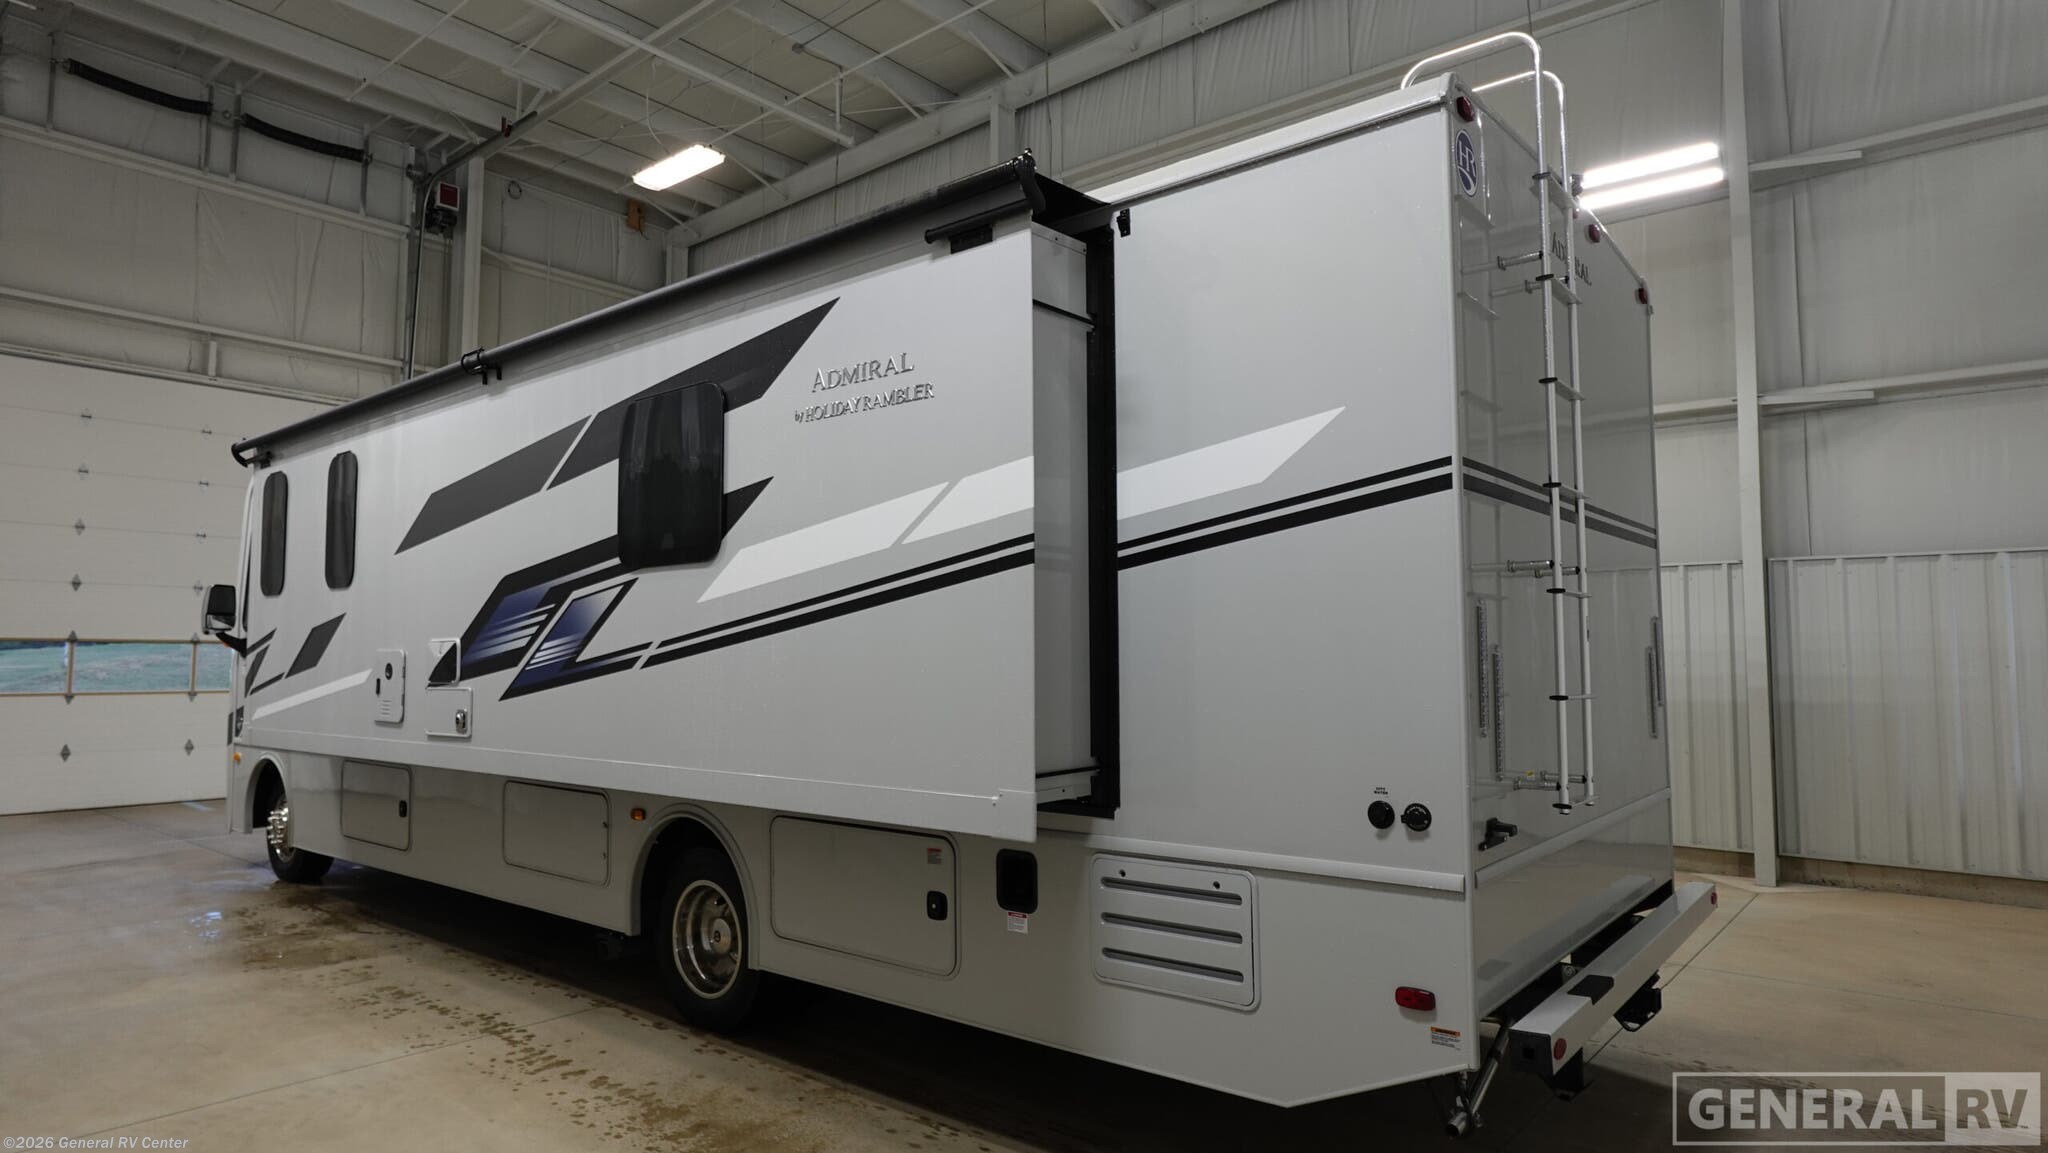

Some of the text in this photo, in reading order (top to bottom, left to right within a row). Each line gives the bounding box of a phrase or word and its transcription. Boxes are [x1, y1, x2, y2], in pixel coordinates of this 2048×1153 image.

[1552, 231, 1592, 286] ADRAL
[812, 352, 915, 393] ADMIRAL
[805, 396, 861, 422] HOLIDAY
[862, 381, 935, 412] RAMBLER
